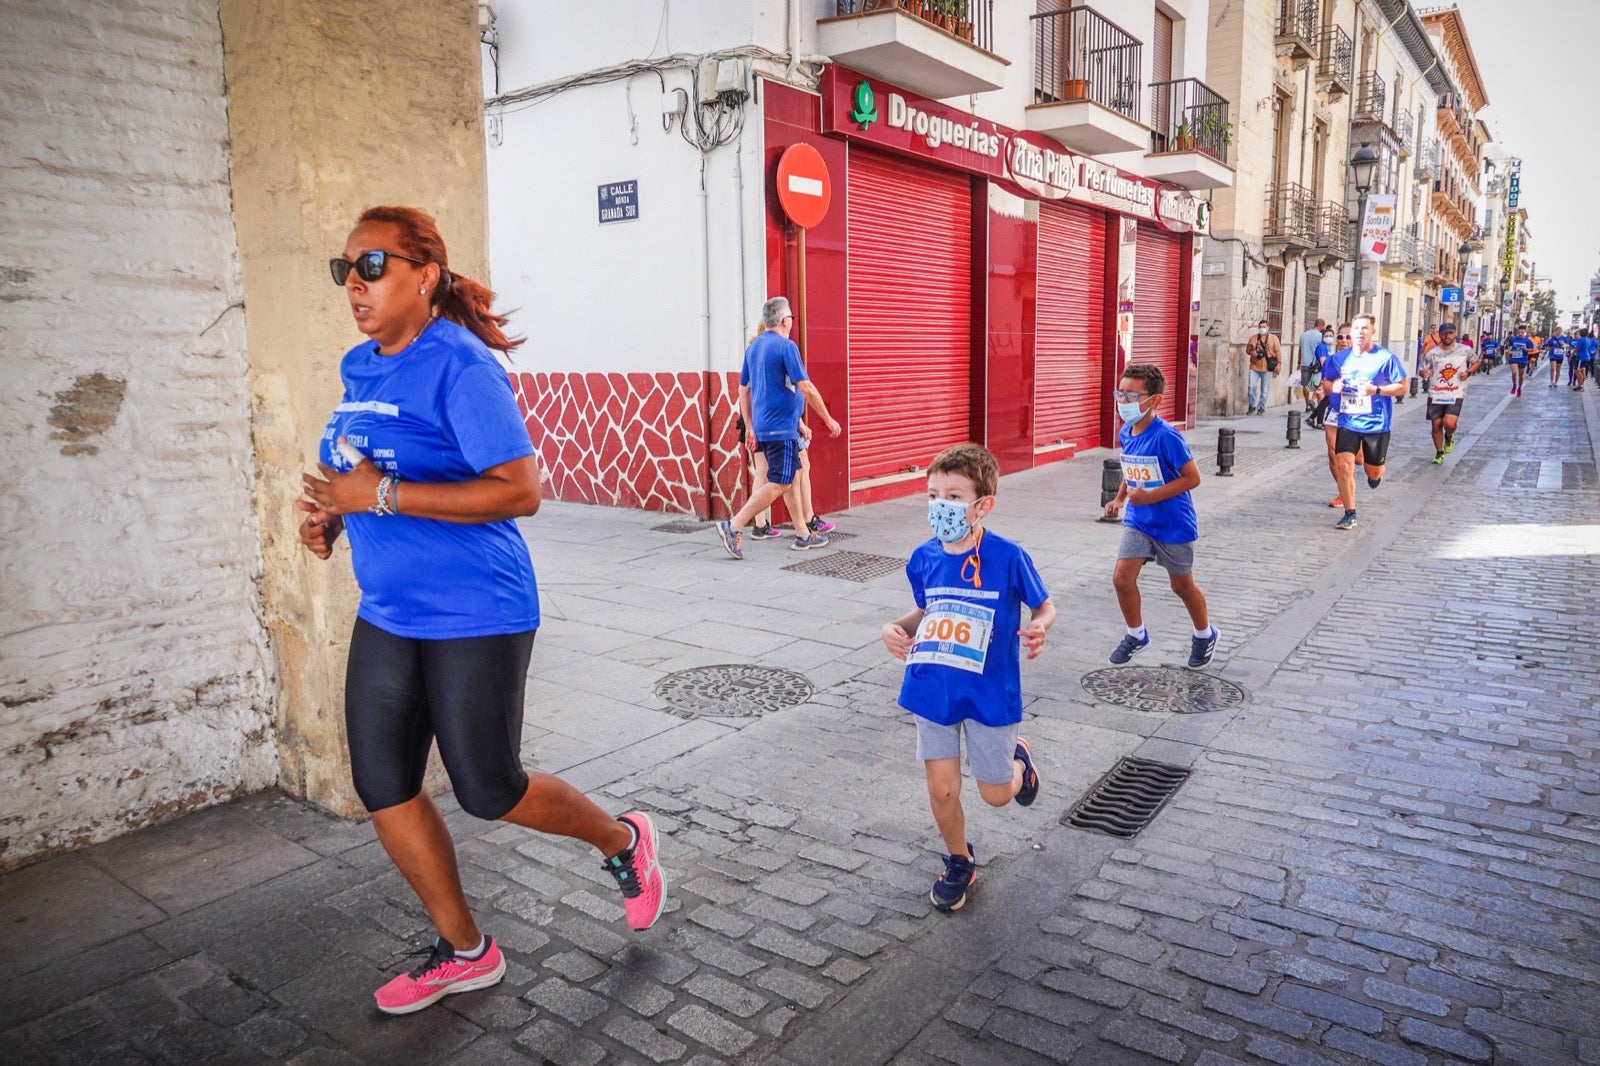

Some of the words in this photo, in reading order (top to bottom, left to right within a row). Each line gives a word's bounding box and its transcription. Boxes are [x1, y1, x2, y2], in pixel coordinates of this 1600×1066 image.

[888, 93, 999, 157] Droguerías
[1012, 138, 1044, 182] Ana
[1043, 149, 1075, 191] Pilar
[610, 184, 634, 195] CALLE
[1085, 164, 1153, 207] Perfumerías
[601, 206, 624, 220] GRANADA
[625, 205, 636, 217] SUR
[1366, 215, 1381, 225] Santa
[1383, 215, 1390, 225] Fe
[1127, 466, 1151, 481] 903
[924, 618, 972, 644] 906
